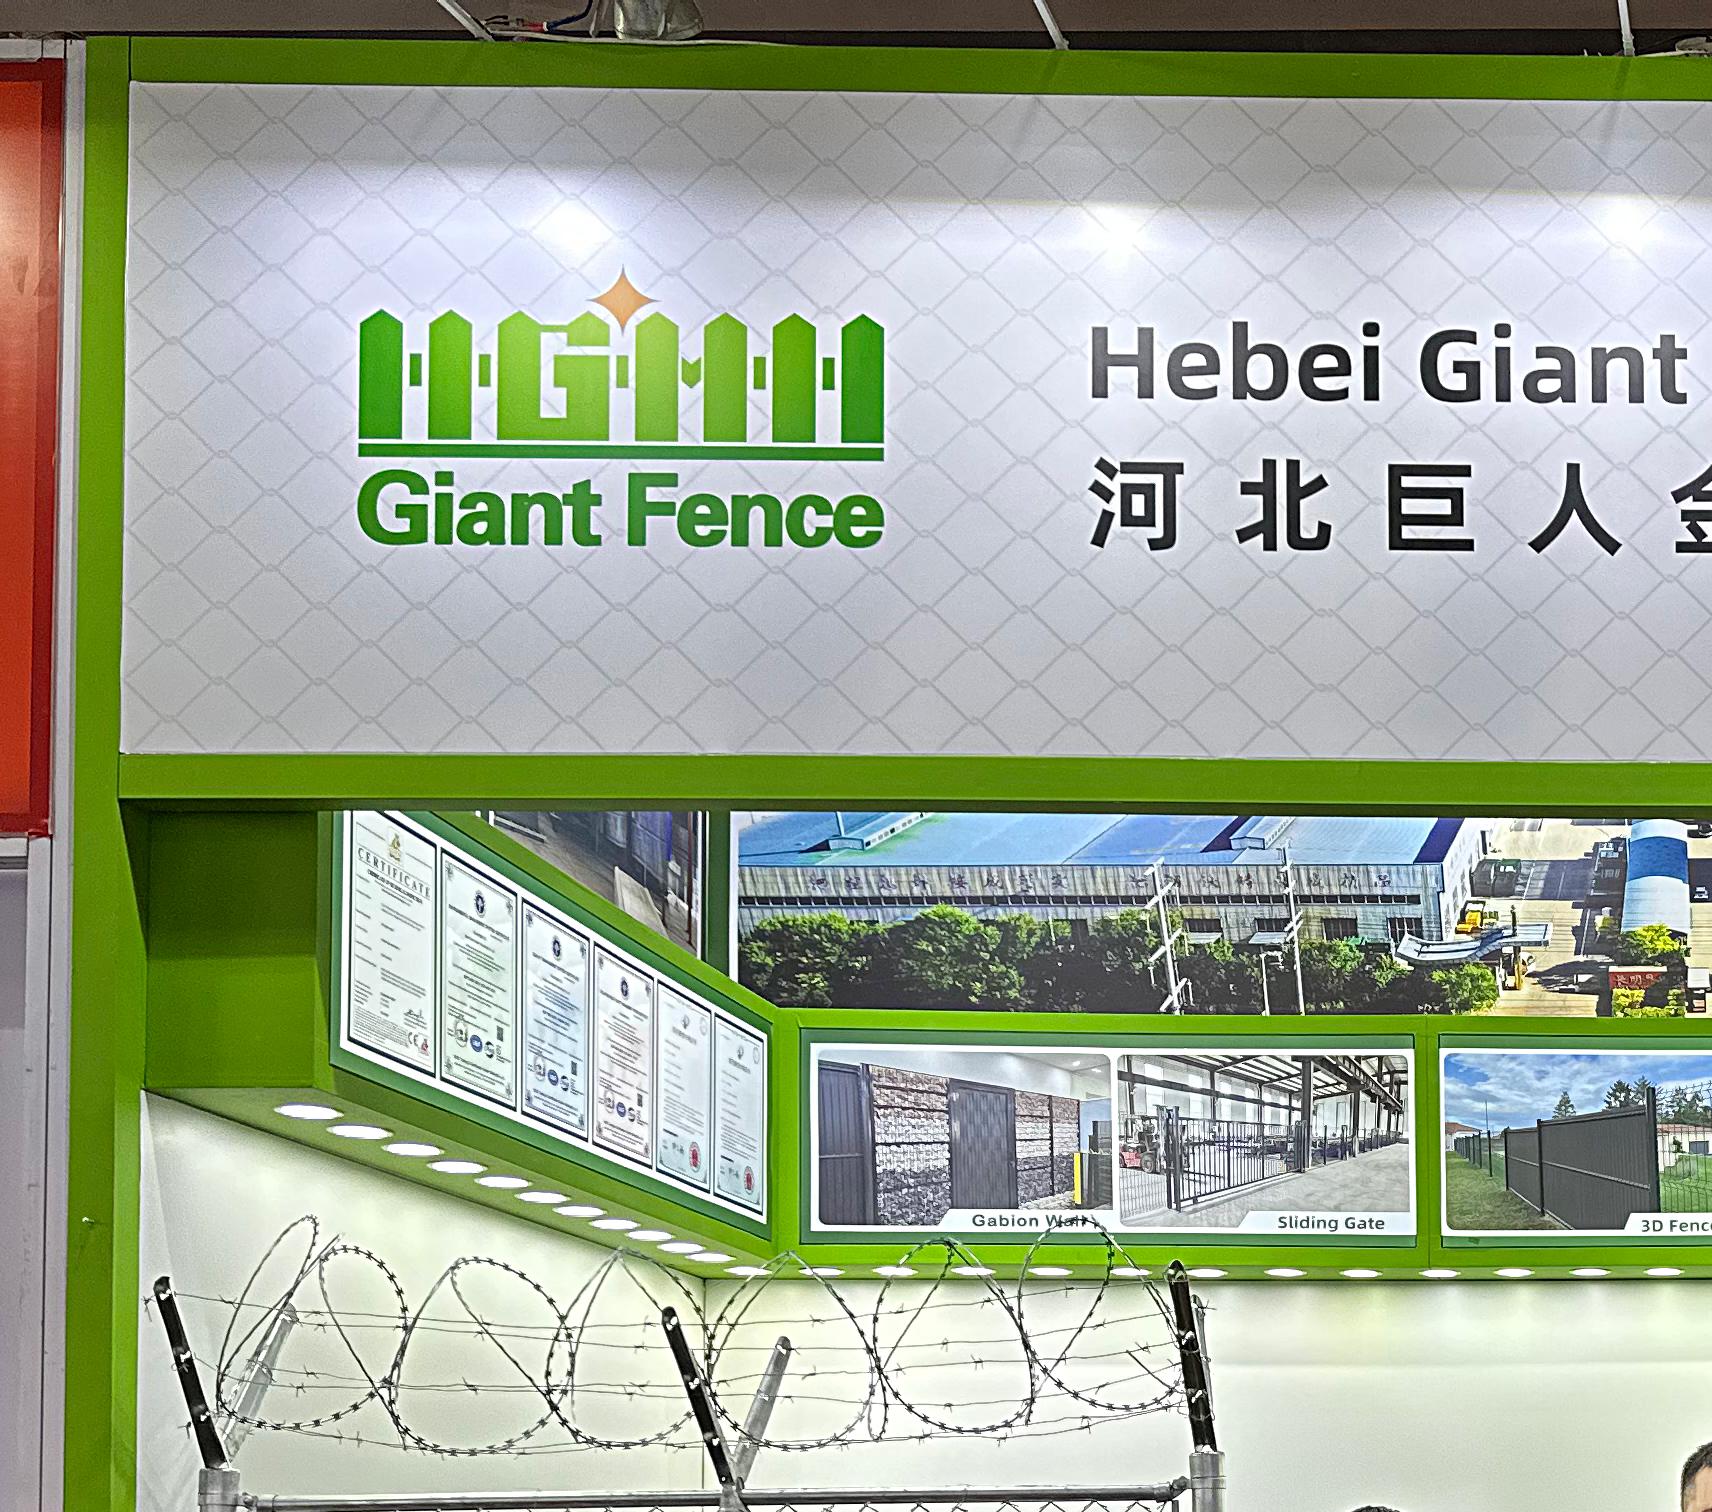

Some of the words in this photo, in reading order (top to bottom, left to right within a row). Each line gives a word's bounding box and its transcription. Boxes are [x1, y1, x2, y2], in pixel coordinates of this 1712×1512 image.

[1090, 321, 1382, 403] Hebei
[1419, 323, 1689, 406] Giant
[357, 469, 602, 547] Giant
[627, 472, 885, 549] Fence
[358, 847, 431, 899] CERTIFICATE
[971, 1214, 1039, 1227] Gabion
[1277, 1216, 1339, 1232] Sliding
[1343, 1217, 1386, 1230] Gate
[1640, 1219, 1664, 1232] 3D
